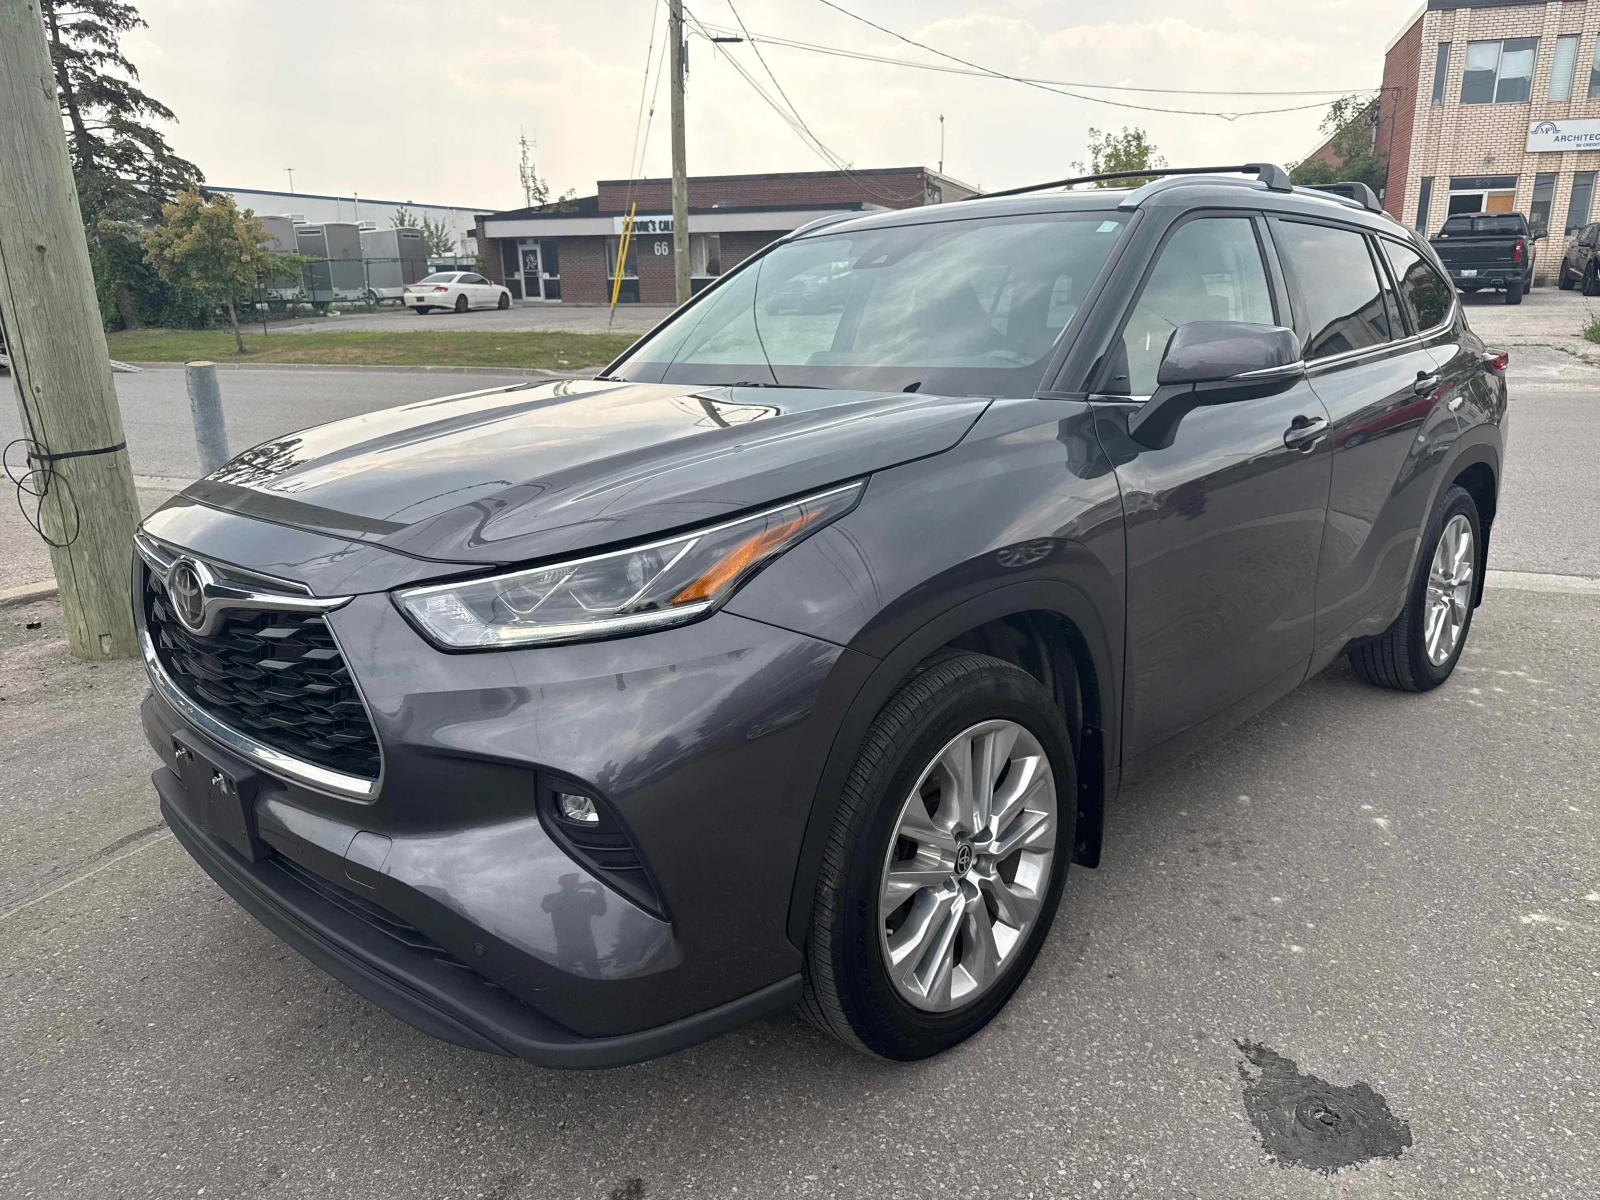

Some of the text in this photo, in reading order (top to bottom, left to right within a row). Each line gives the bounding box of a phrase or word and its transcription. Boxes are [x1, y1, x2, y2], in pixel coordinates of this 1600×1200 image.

[1554, 134, 1600, 142] ARCHITEC
[622, 220, 656, 232] TURE'S
[654, 242, 669, 255] 66
